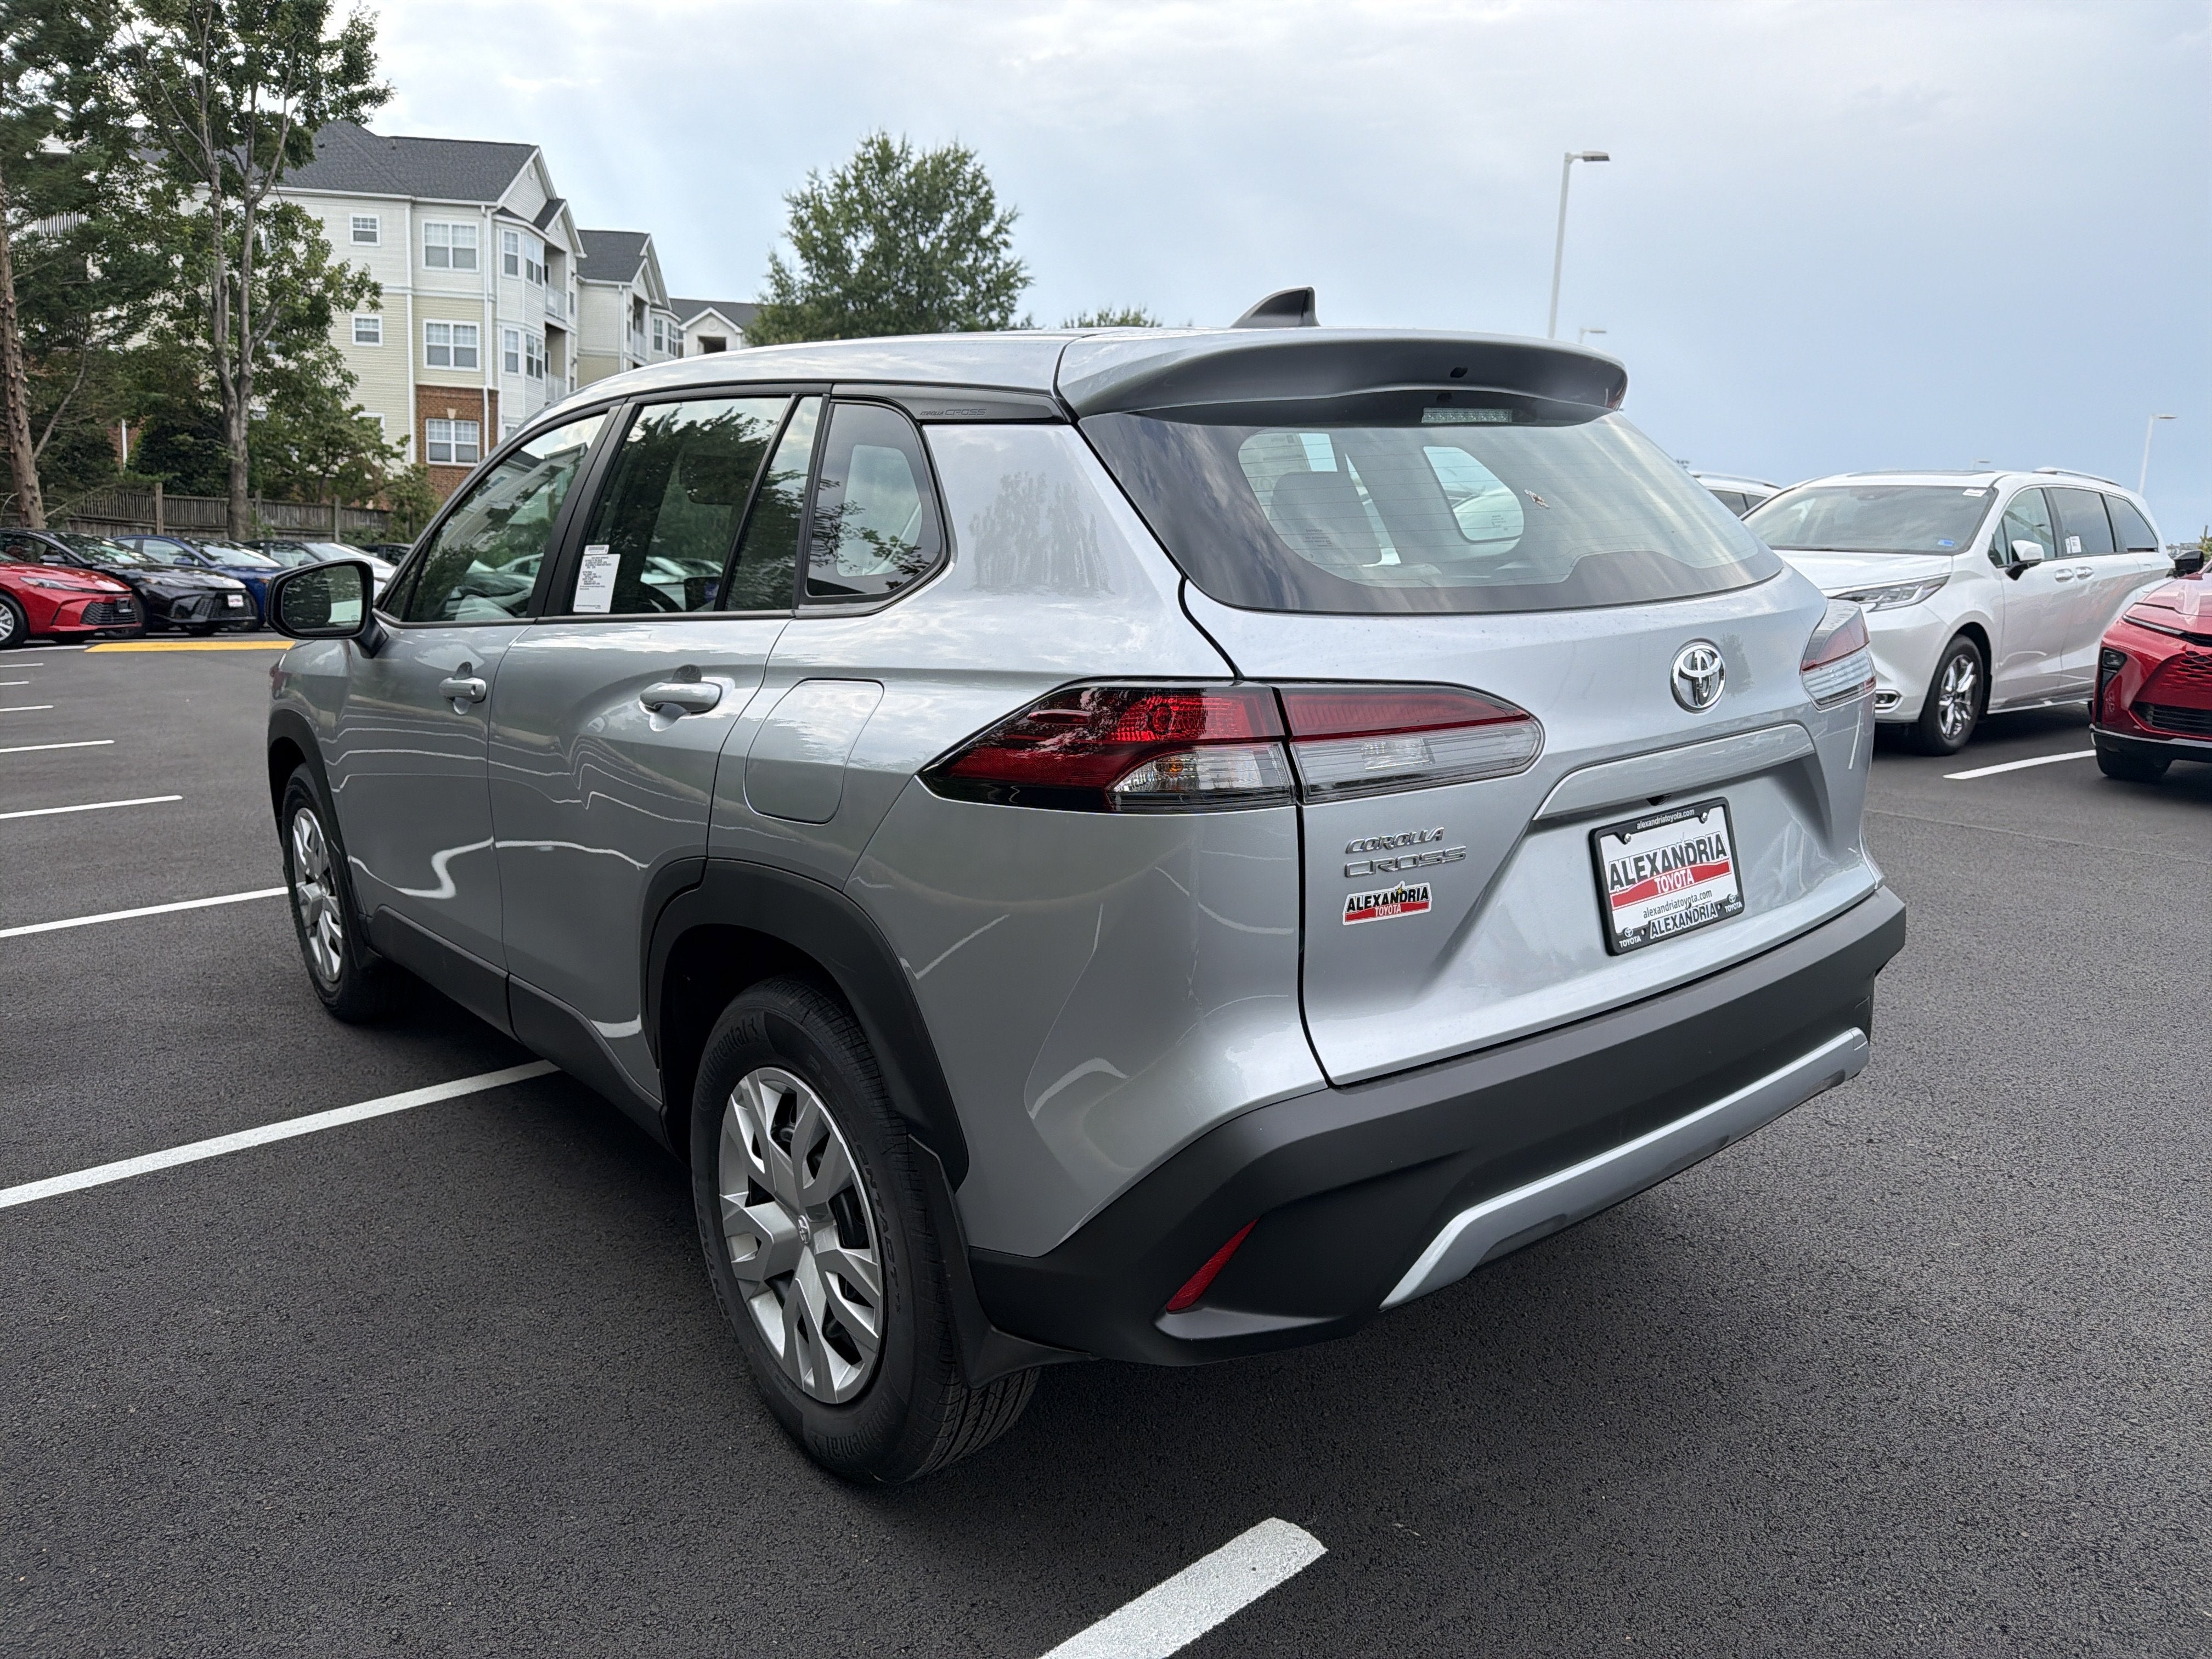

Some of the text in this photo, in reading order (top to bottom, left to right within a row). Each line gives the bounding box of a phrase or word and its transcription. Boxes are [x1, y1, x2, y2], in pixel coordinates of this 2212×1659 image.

[1636, 808, 1695, 830] alexandriatoyota.com
[1345, 825, 1444, 854] COROLLA
[1344, 845, 1466, 878] CROSS
[1609, 832, 1728, 891] ALEXANDRIA
[1654, 868, 1695, 894] TOYOTA
[1346, 886, 1430, 912] ALEXANDRIA
[1374, 904, 1402, 917] TOYOTA
[1642, 889, 1713, 919] alexandriatoyota.com
[1724, 901, 1743, 913] TOYOTA
[1650, 902, 1718, 938] ALEXANDRIA
[1618, 935, 1642, 948] TOYOTA
